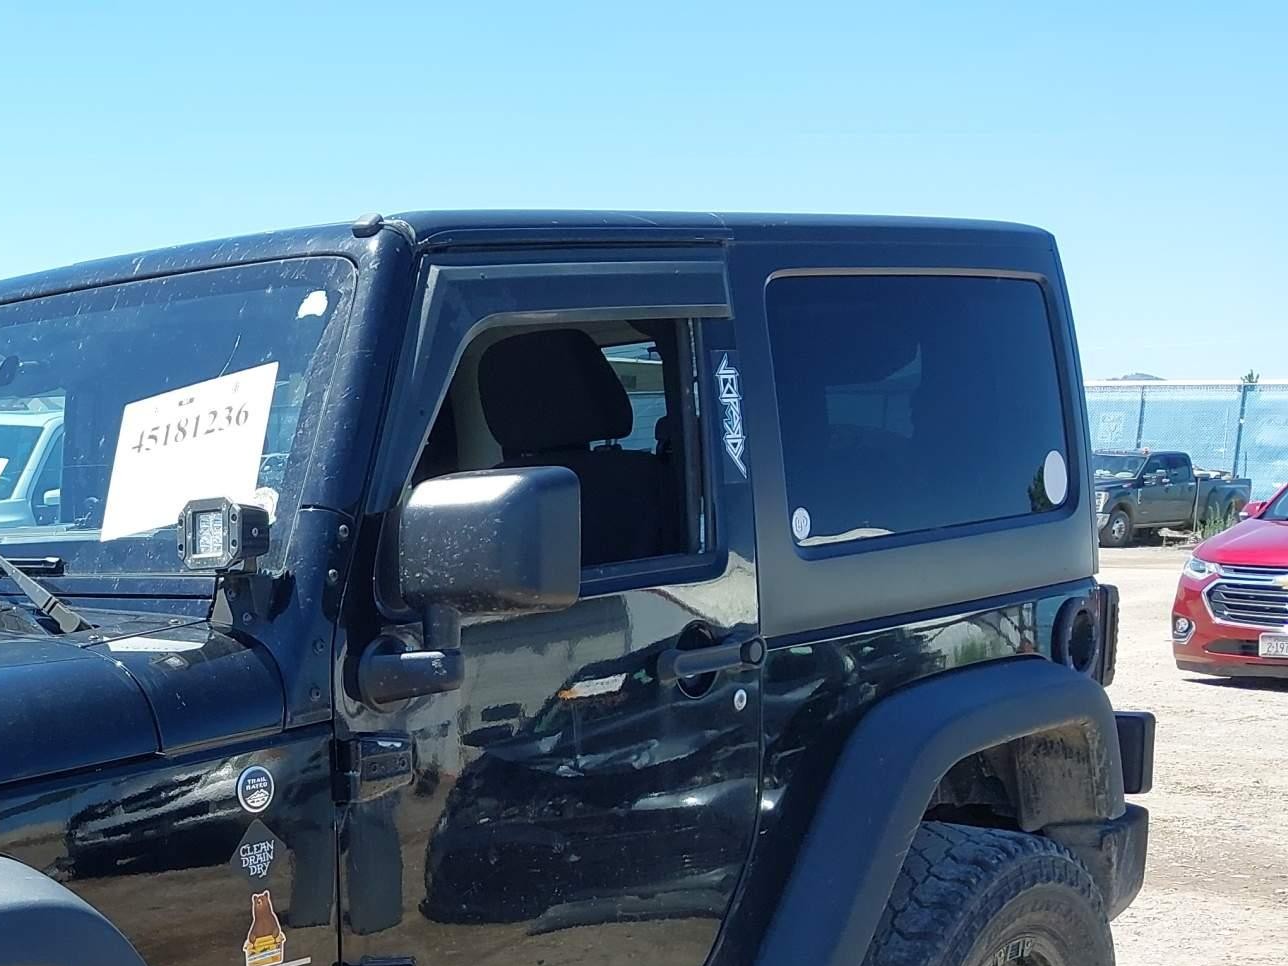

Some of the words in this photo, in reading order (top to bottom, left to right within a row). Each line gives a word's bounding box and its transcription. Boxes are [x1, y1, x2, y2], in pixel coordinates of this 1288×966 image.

[131, 402, 250, 453] 45181236
[245, 781, 268, 791] RATED
[247, 776, 266, 785] TRAIL
[240, 839, 274, 857] CLEAN
[241, 850, 274, 867] DRAIN
[249, 861, 270, 878] DRY
